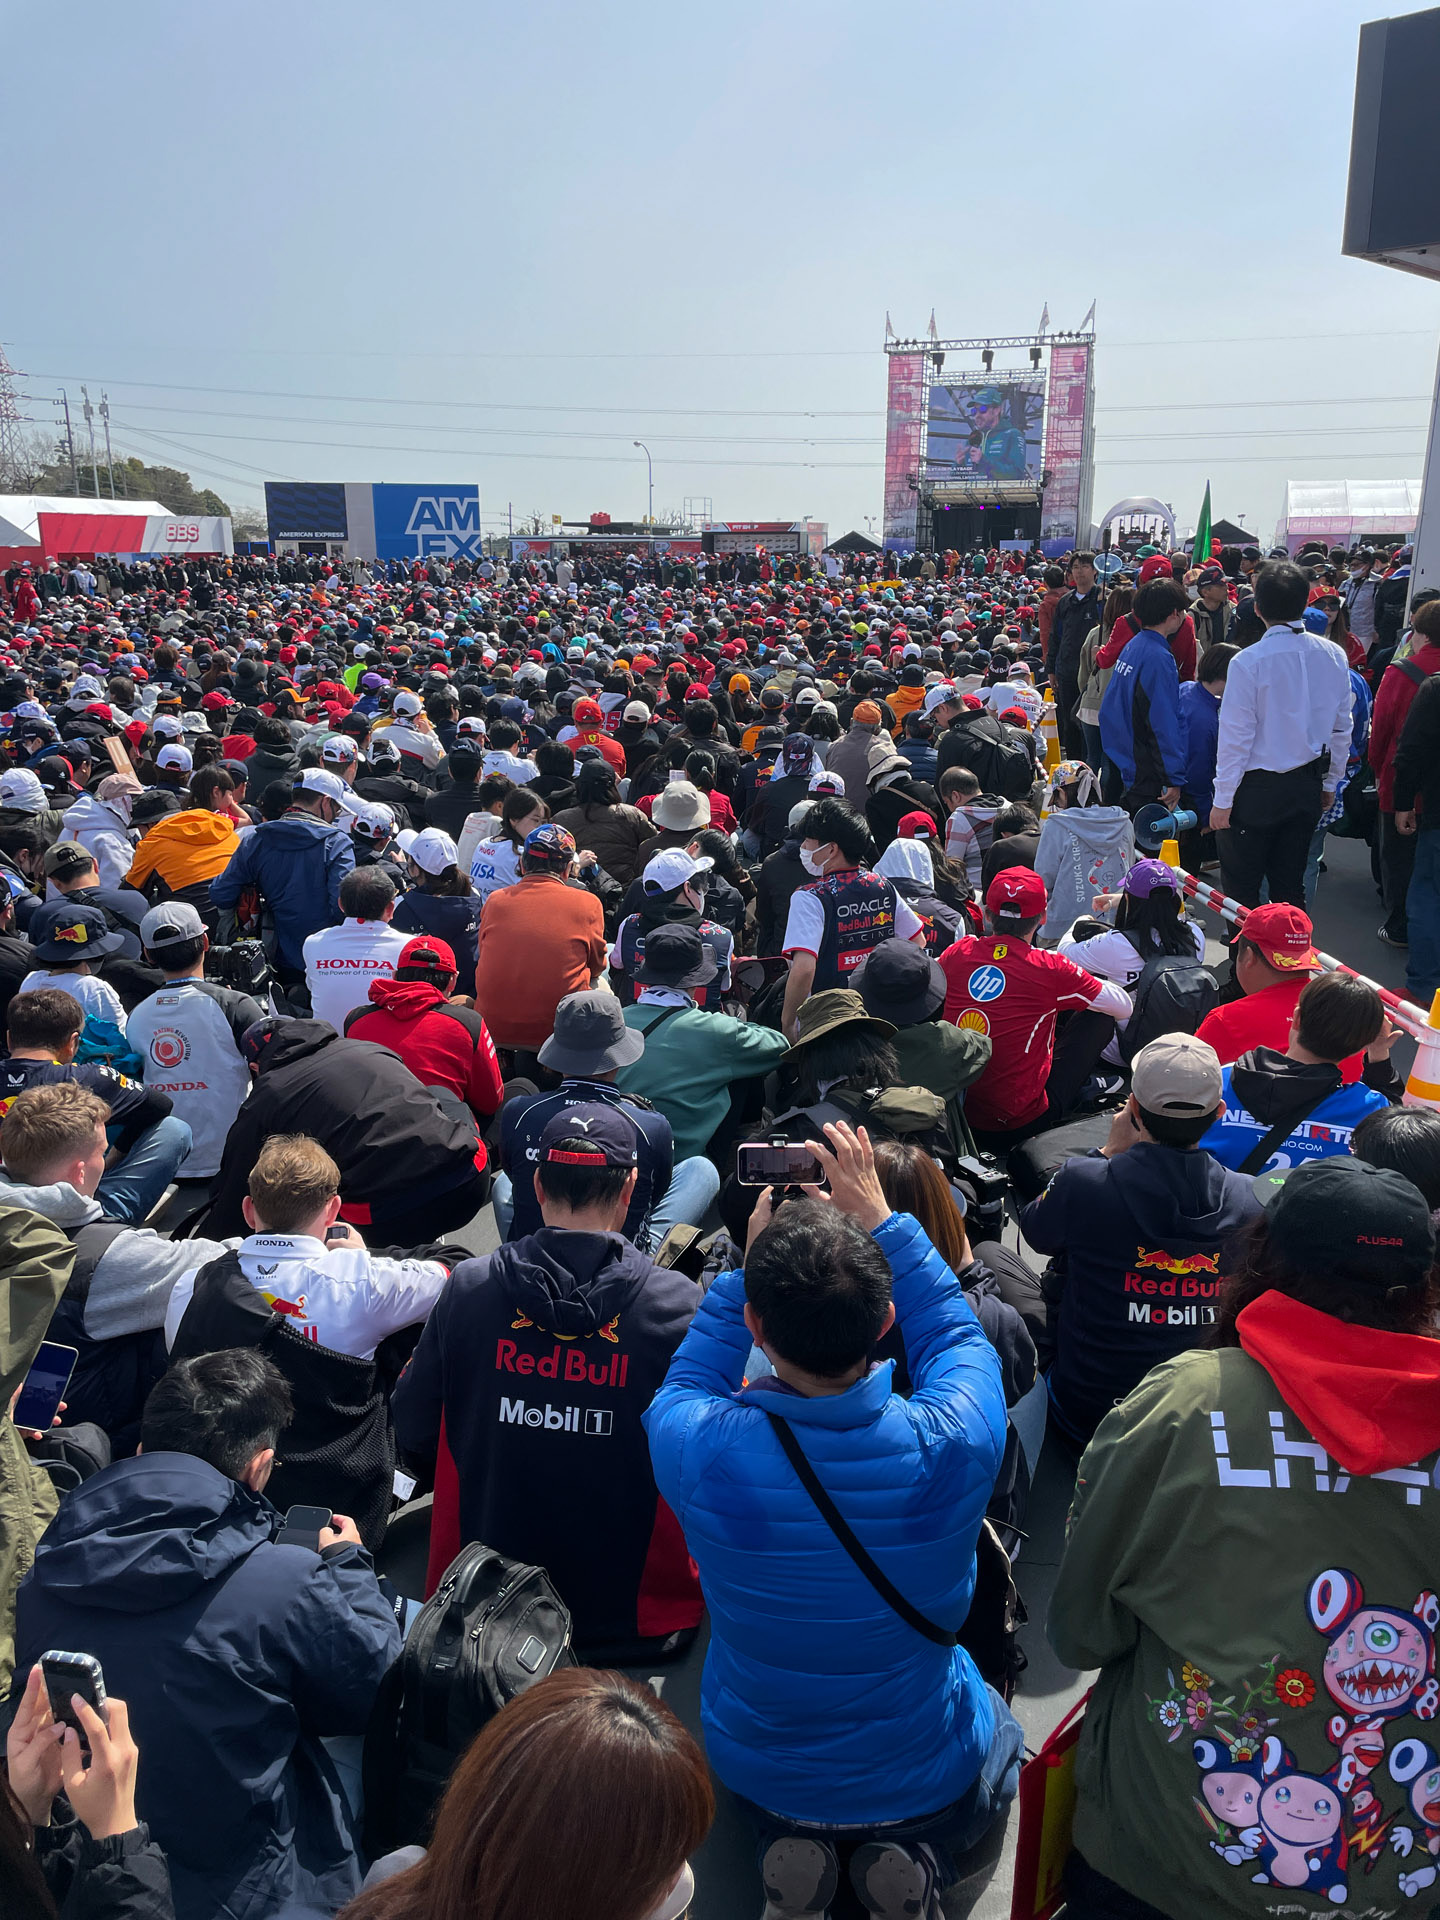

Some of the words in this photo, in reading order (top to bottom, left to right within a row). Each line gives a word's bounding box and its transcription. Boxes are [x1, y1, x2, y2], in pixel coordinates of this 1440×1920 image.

[166, 523, 200, 542] BBS
[1293, 521, 1325, 529] OFFICIAL
[755, 779, 768, 787] Re
[1069, 832, 1081, 862] CIRCU
[470, 862, 496, 880] VISA
[1073, 863, 1086, 903] SUZUKA
[837, 896, 891, 918] ORACLE
[838, 917, 854, 933] Red
[854, 916, 871, 930] Bull
[839, 928, 895, 945] RACING
[316, 959, 395, 970] HONDA
[971, 965, 1003, 1001] hp
[255, 1239, 295, 1248] HONDA
[1357, 1235, 1403, 1246] PLUS44
[1124, 1272, 1178, 1296] Red
[1128, 1302, 1197, 1325] Mobil
[495, 1338, 561, 1379] Red
[564, 1349, 629, 1388] Bull
[498, 1396, 580, 1433] Mobil
